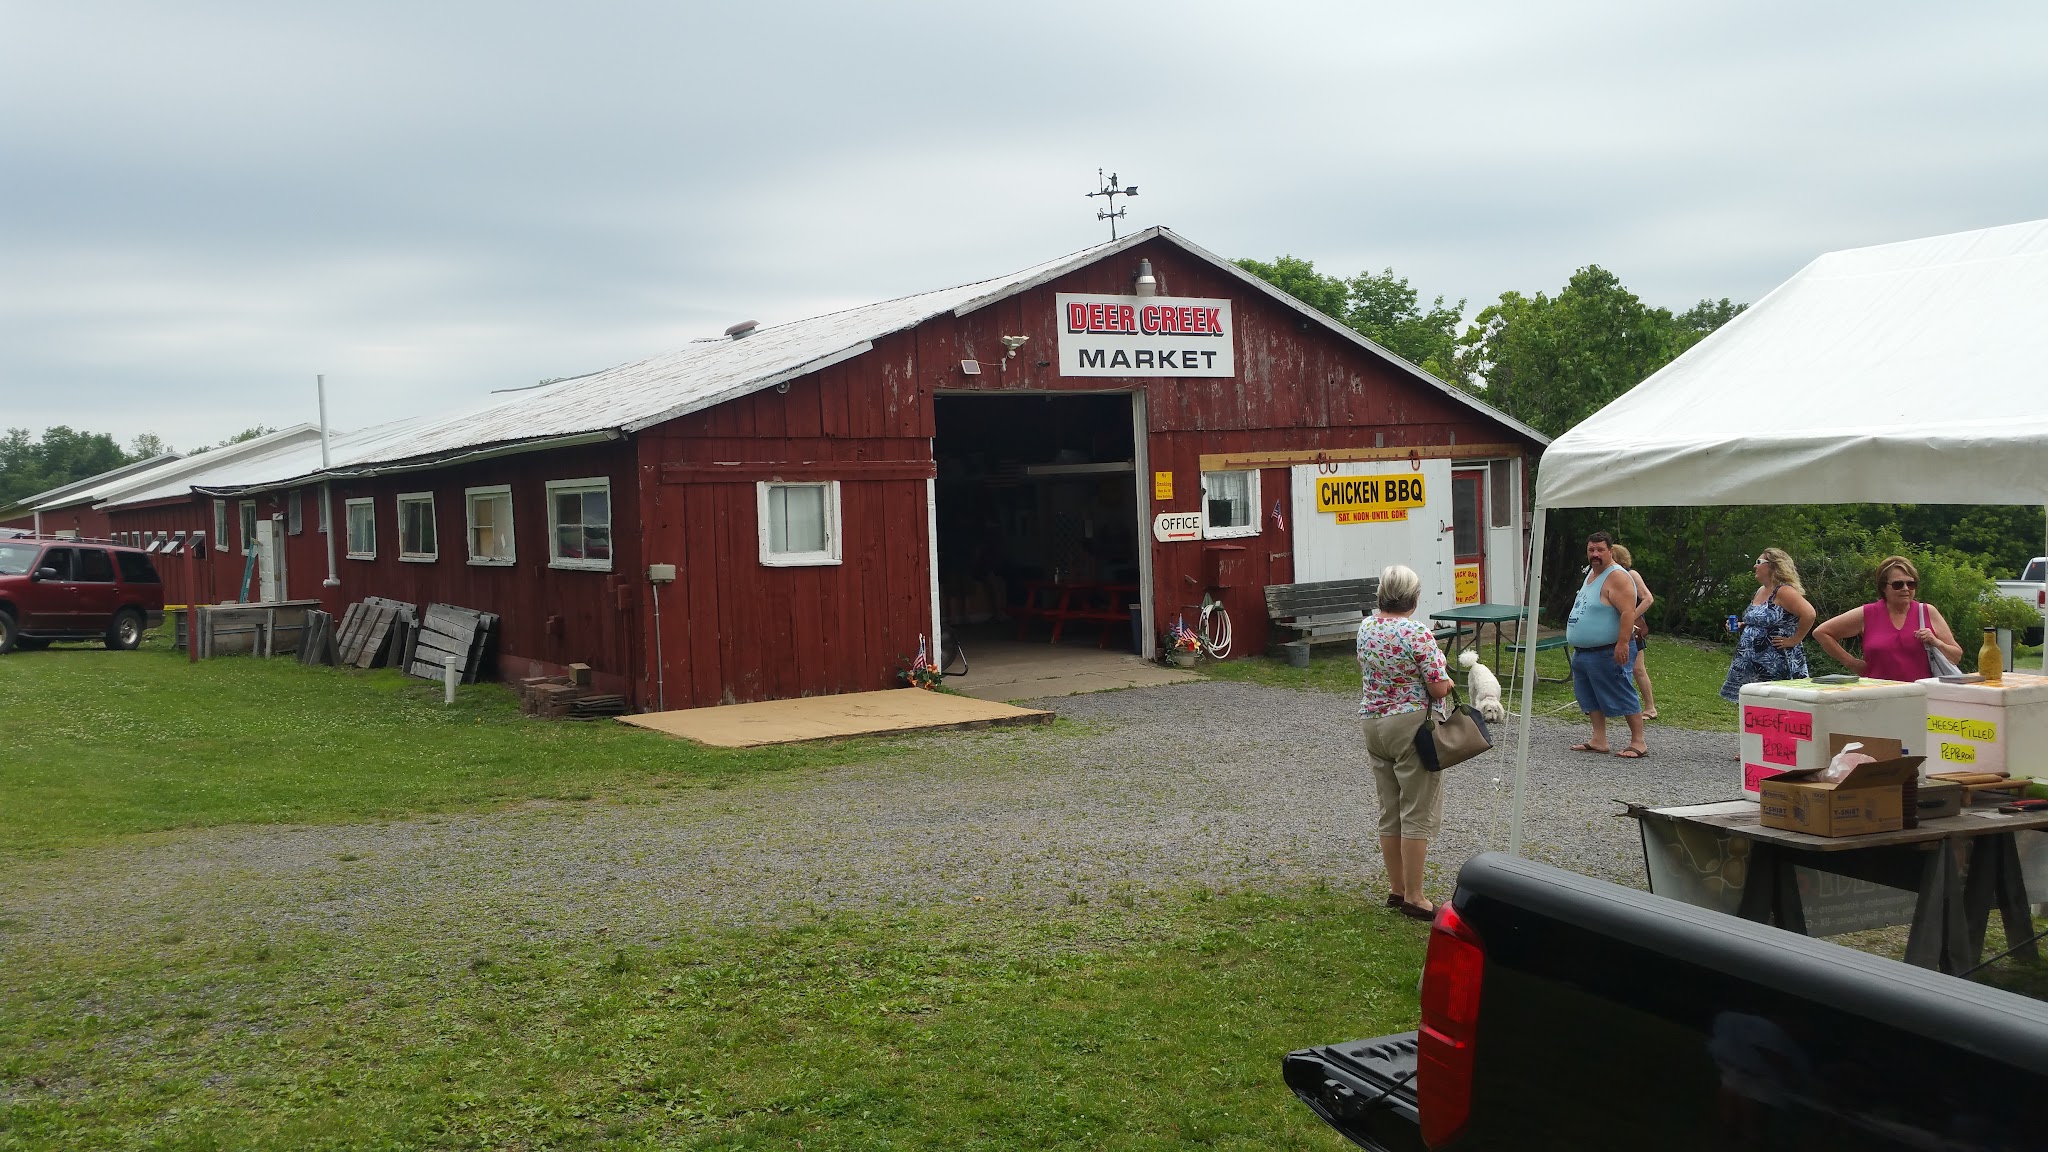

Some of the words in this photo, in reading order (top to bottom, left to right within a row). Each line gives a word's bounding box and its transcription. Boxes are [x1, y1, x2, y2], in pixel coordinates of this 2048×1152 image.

[1067, 302, 1139, 335] DEER
[1140, 304, 1224, 337] CREEK
[1079, 348, 1217, 369] MARKET
[1321, 481, 1379, 506] CHICKEN
[1384, 478, 1423, 503] BBQ
[1353, 511, 1370, 522] NOON
[1371, 510, 1389, 520] UNTIL
[1391, 509, 1407, 519] GONE
[1161, 517, 1199, 530] OFFICE
[1763, 806, 1788, 815] T-SHIRT
[1833, 807, 1860, 816] T-SHIRT
